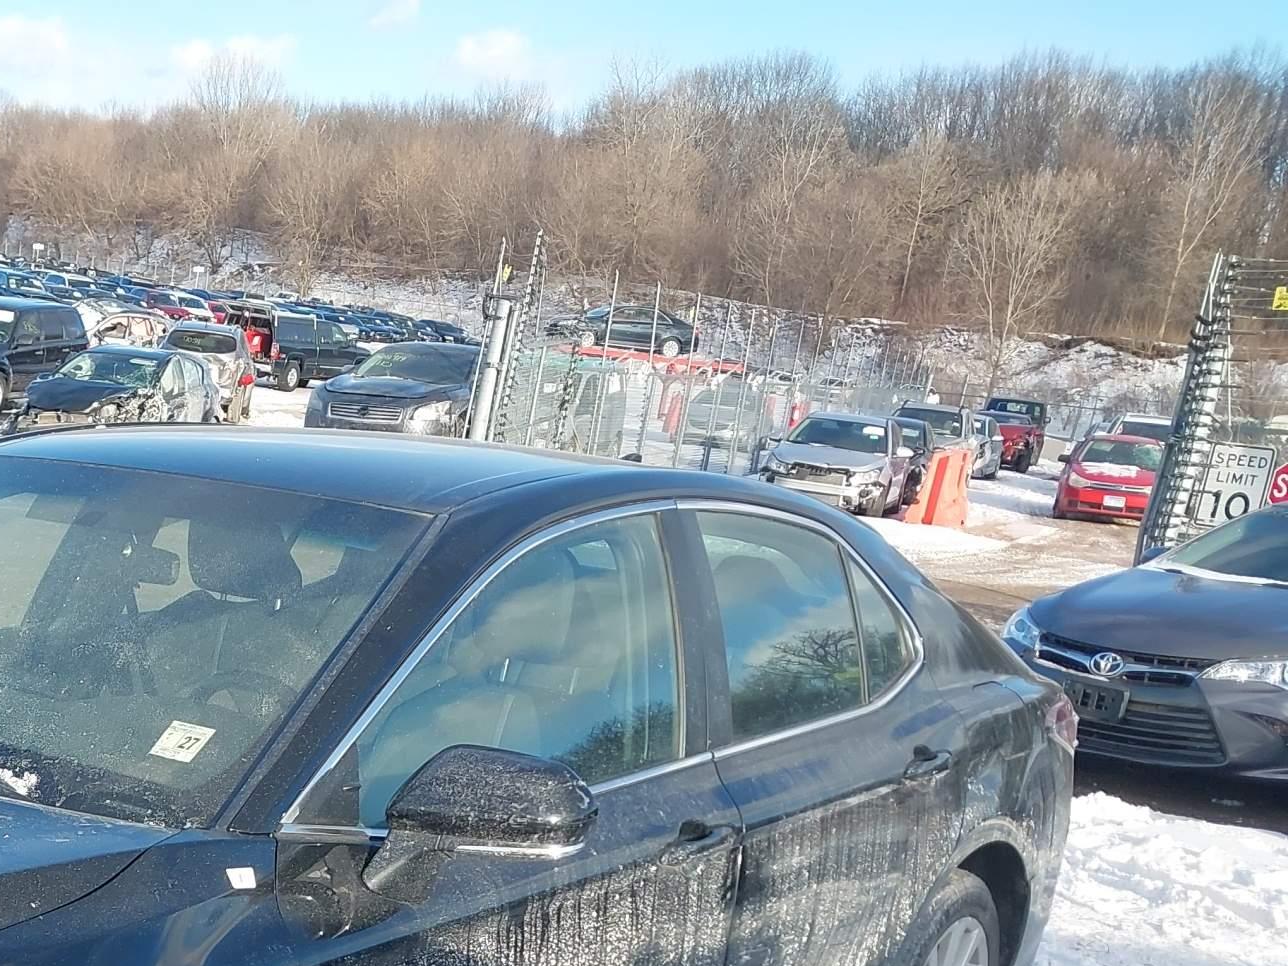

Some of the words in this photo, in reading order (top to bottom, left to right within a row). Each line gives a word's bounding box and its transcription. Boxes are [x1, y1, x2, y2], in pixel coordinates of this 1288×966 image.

[1215, 452, 1268, 469] SPEED
[1216, 471, 1259, 487] LIMIT
[1210, 490, 1250, 520] 10
[176, 736, 202, 750] 27
